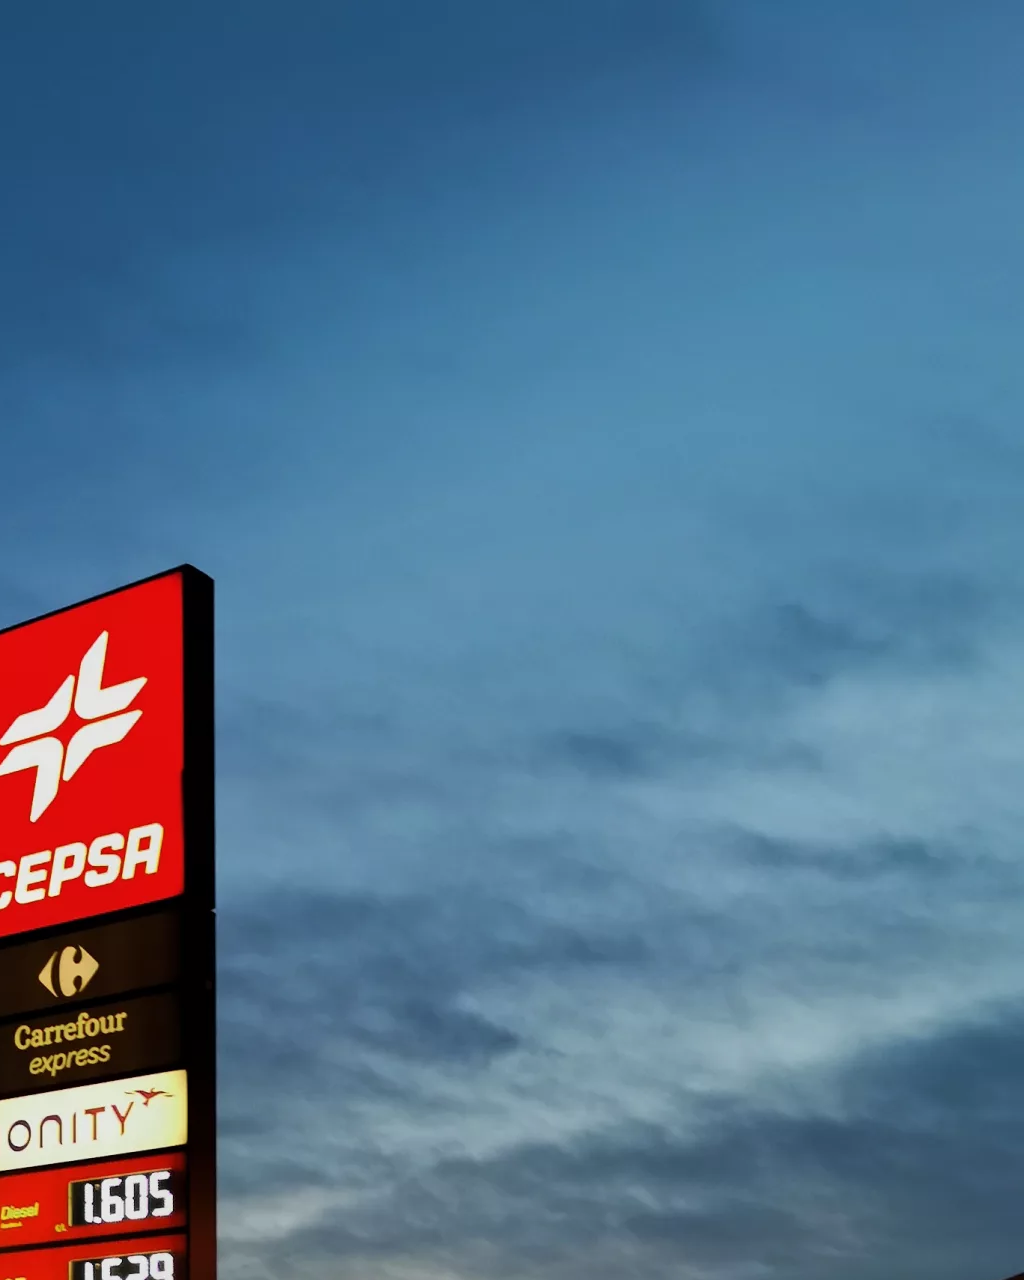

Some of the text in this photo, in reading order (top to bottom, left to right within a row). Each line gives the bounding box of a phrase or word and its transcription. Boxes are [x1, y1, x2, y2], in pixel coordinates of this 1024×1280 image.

[14, 1011, 128, 1050] Carrefour
[29, 1043, 112, 1076] express
[1, 1202, 40, 1221] Diesel
[84, 1171, 174, 1224] 1.605
